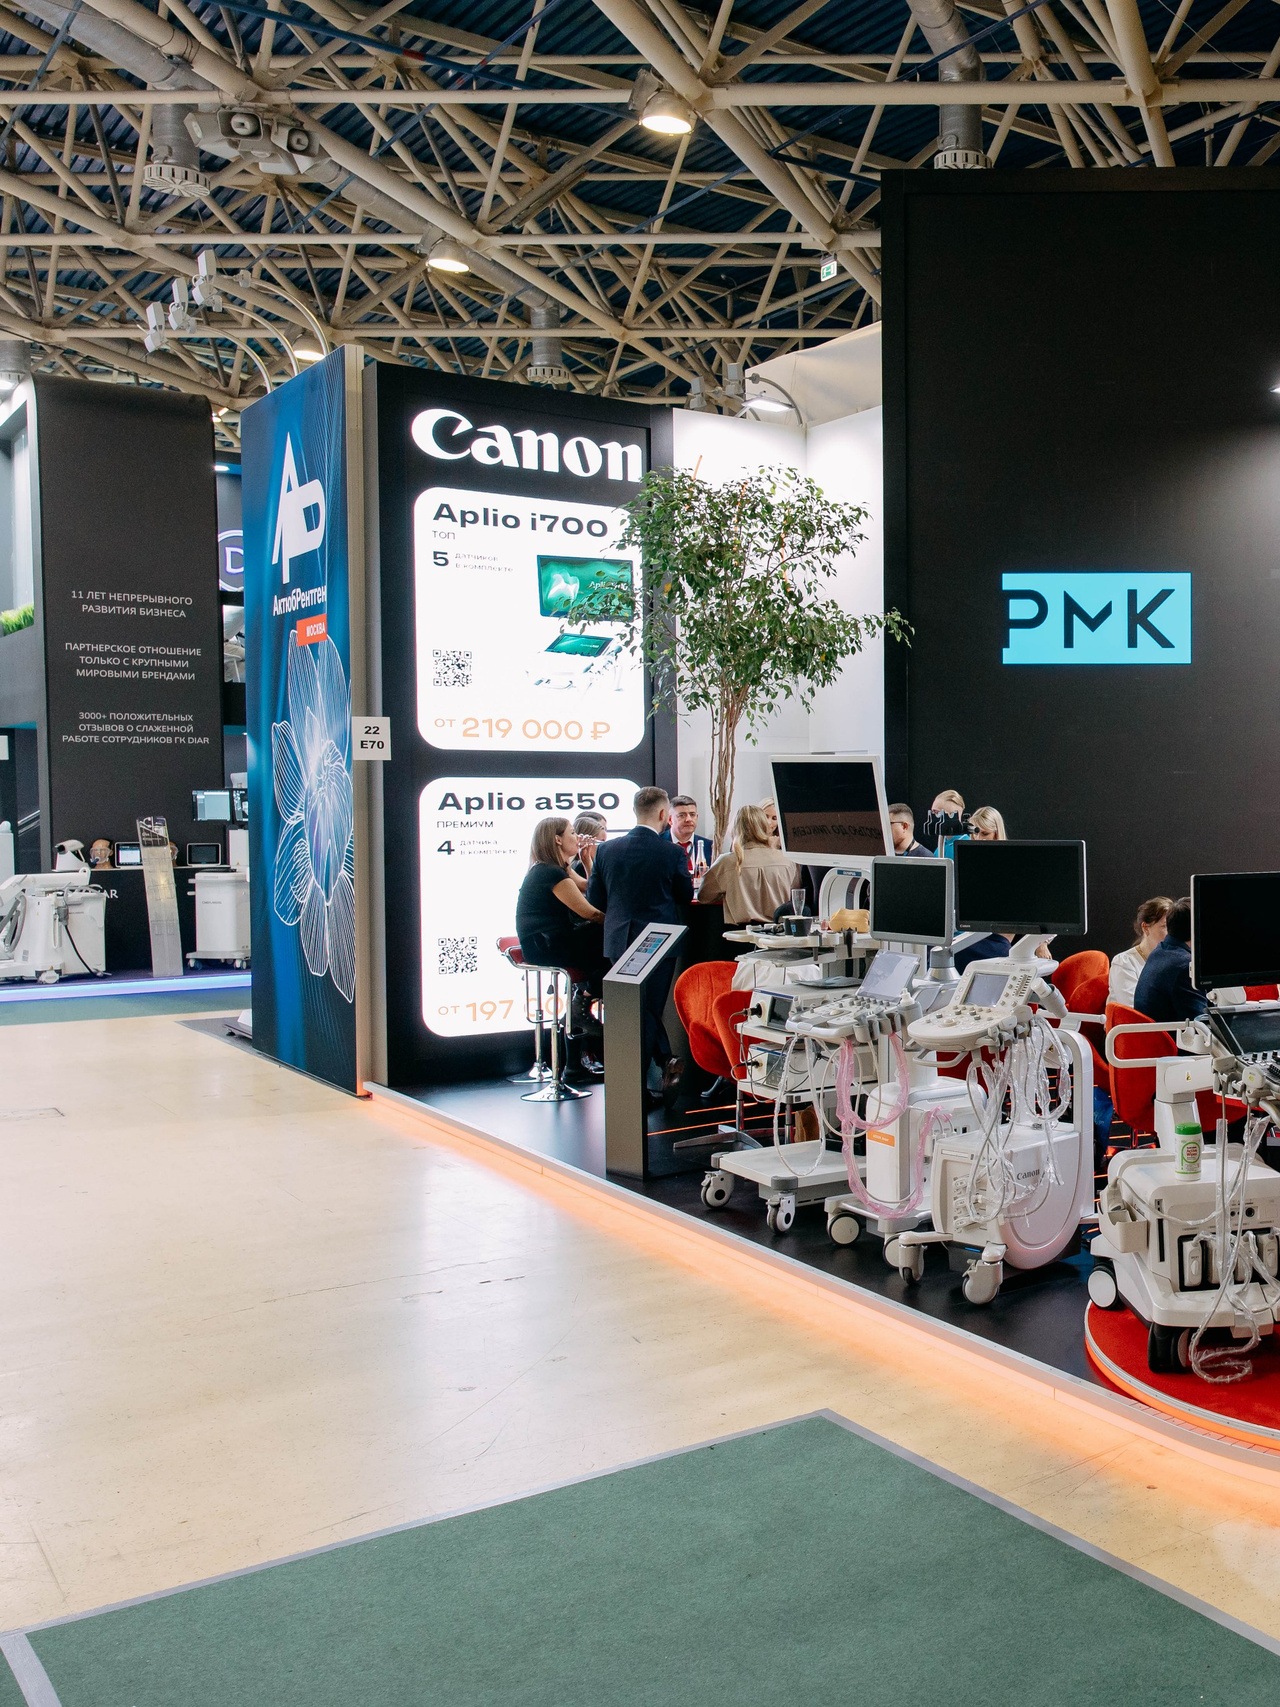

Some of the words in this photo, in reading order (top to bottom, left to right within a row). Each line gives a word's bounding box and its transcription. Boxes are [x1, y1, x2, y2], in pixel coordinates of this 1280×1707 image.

[411, 408, 642, 483] Canon
[433, 502, 521, 531] Aplio
[530, 512, 608, 537] i700
[433, 550, 449, 567] 5
[455, 553, 498, 561] датчиков
[71, 590, 83, 599] 11
[86, 592, 106, 600] ЛЕТ
[109, 592, 193, 606] НЕПРЕРЫВНОГО
[273, 585, 327, 616] АктюбРентген
[82, 604, 137, 616] РАЗВИТИЯ
[139, 607, 186, 618] БИЗНЕСА
[306, 622, 325, 637] МОСКВА
[65, 642, 136, 654] ПАРТНЕРСКОЕ
[138, 645, 202, 656] ОТНОШЕНИЕ
[79, 655, 120, 666] ТОЛЬКО
[123, 658, 129, 666] С
[132, 658, 189, 668] КРУПНЫМИ
[76, 668, 139, 679] МИРОВЫМИ
[141, 671, 195, 681] БРЕНДАМИ
[79, 711, 107, 720] 3000+
[109, 712, 194, 722] ПОЛОЖИТЕЛЬНЫХ
[79, 724, 124, 732] ОТЗЫВОВ
[136, 723, 194, 733] СЛАЖЕННОЙ
[364, 725, 380, 735] 22
[462, 717, 512, 738] 219
[522, 720, 583, 740] 000
[590, 721, 611, 740] ₽
[62, 735, 100, 743] РАБОТЕ
[102, 736, 172, 744] СОТРУДНИКОВ
[174, 736, 186, 744] ГК
[360, 739, 385, 749] E70
[438, 792, 525, 815] Aplio
[535, 793, 619, 811] a550
[437, 840, 455, 855] 4
[466, 1000, 514, 1022] 197
[1016, 1169, 1040, 1180] Canon
